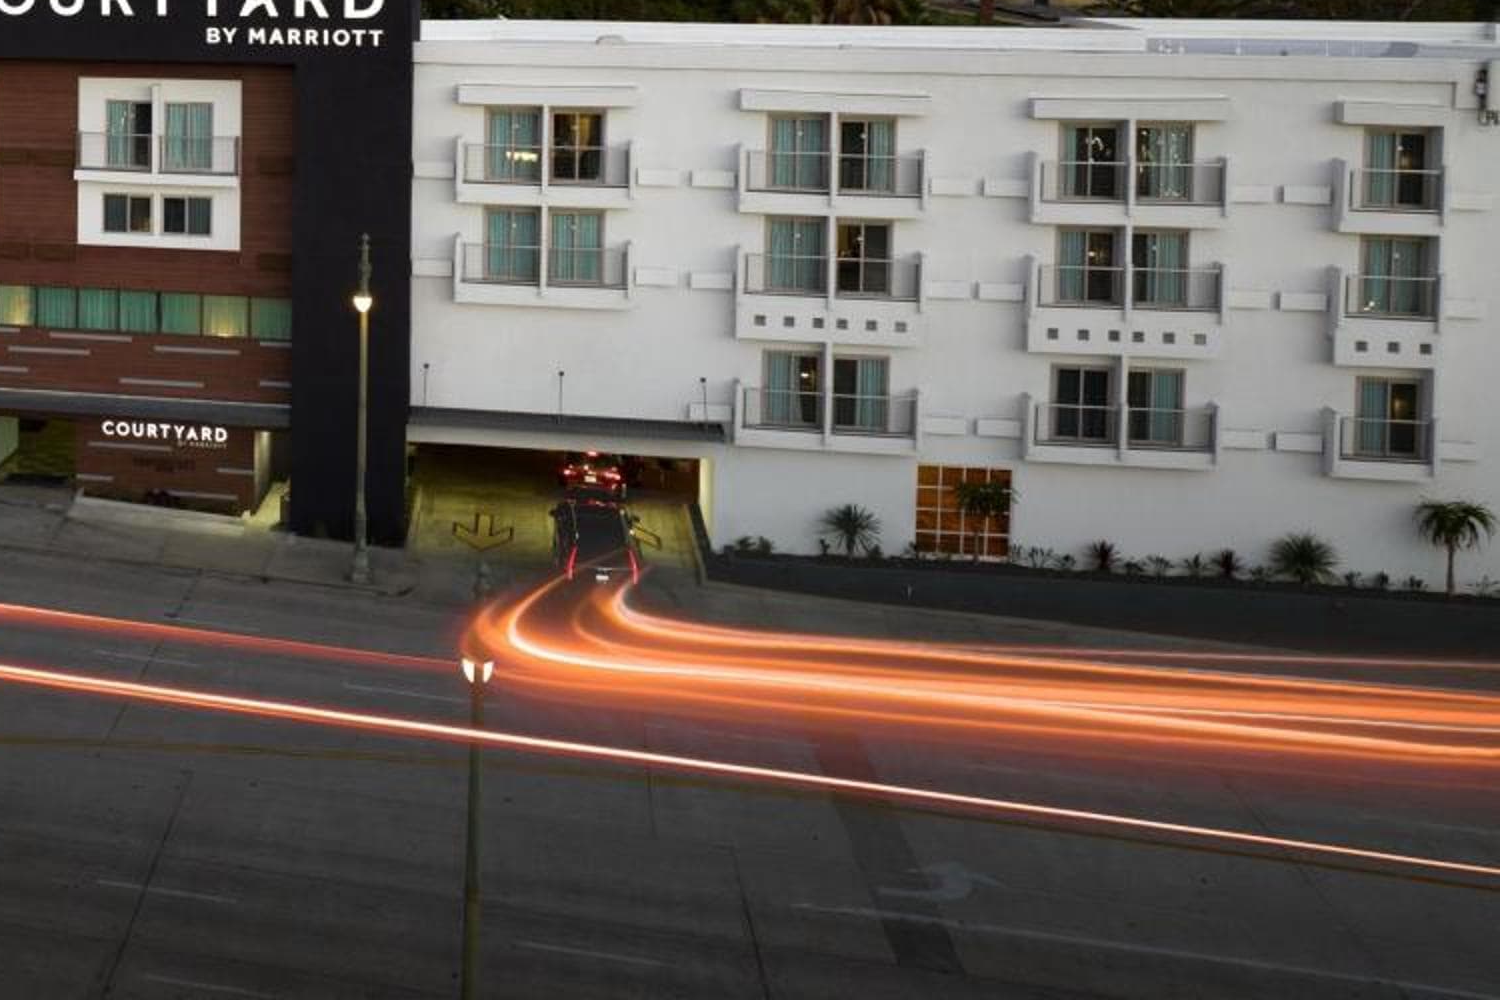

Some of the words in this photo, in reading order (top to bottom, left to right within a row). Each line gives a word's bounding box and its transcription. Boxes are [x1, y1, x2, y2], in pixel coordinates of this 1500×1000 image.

[205, 26, 238, 44] BY
[247, 27, 384, 47] MARRIOTT
[101, 420, 228, 443] COURTYARD
